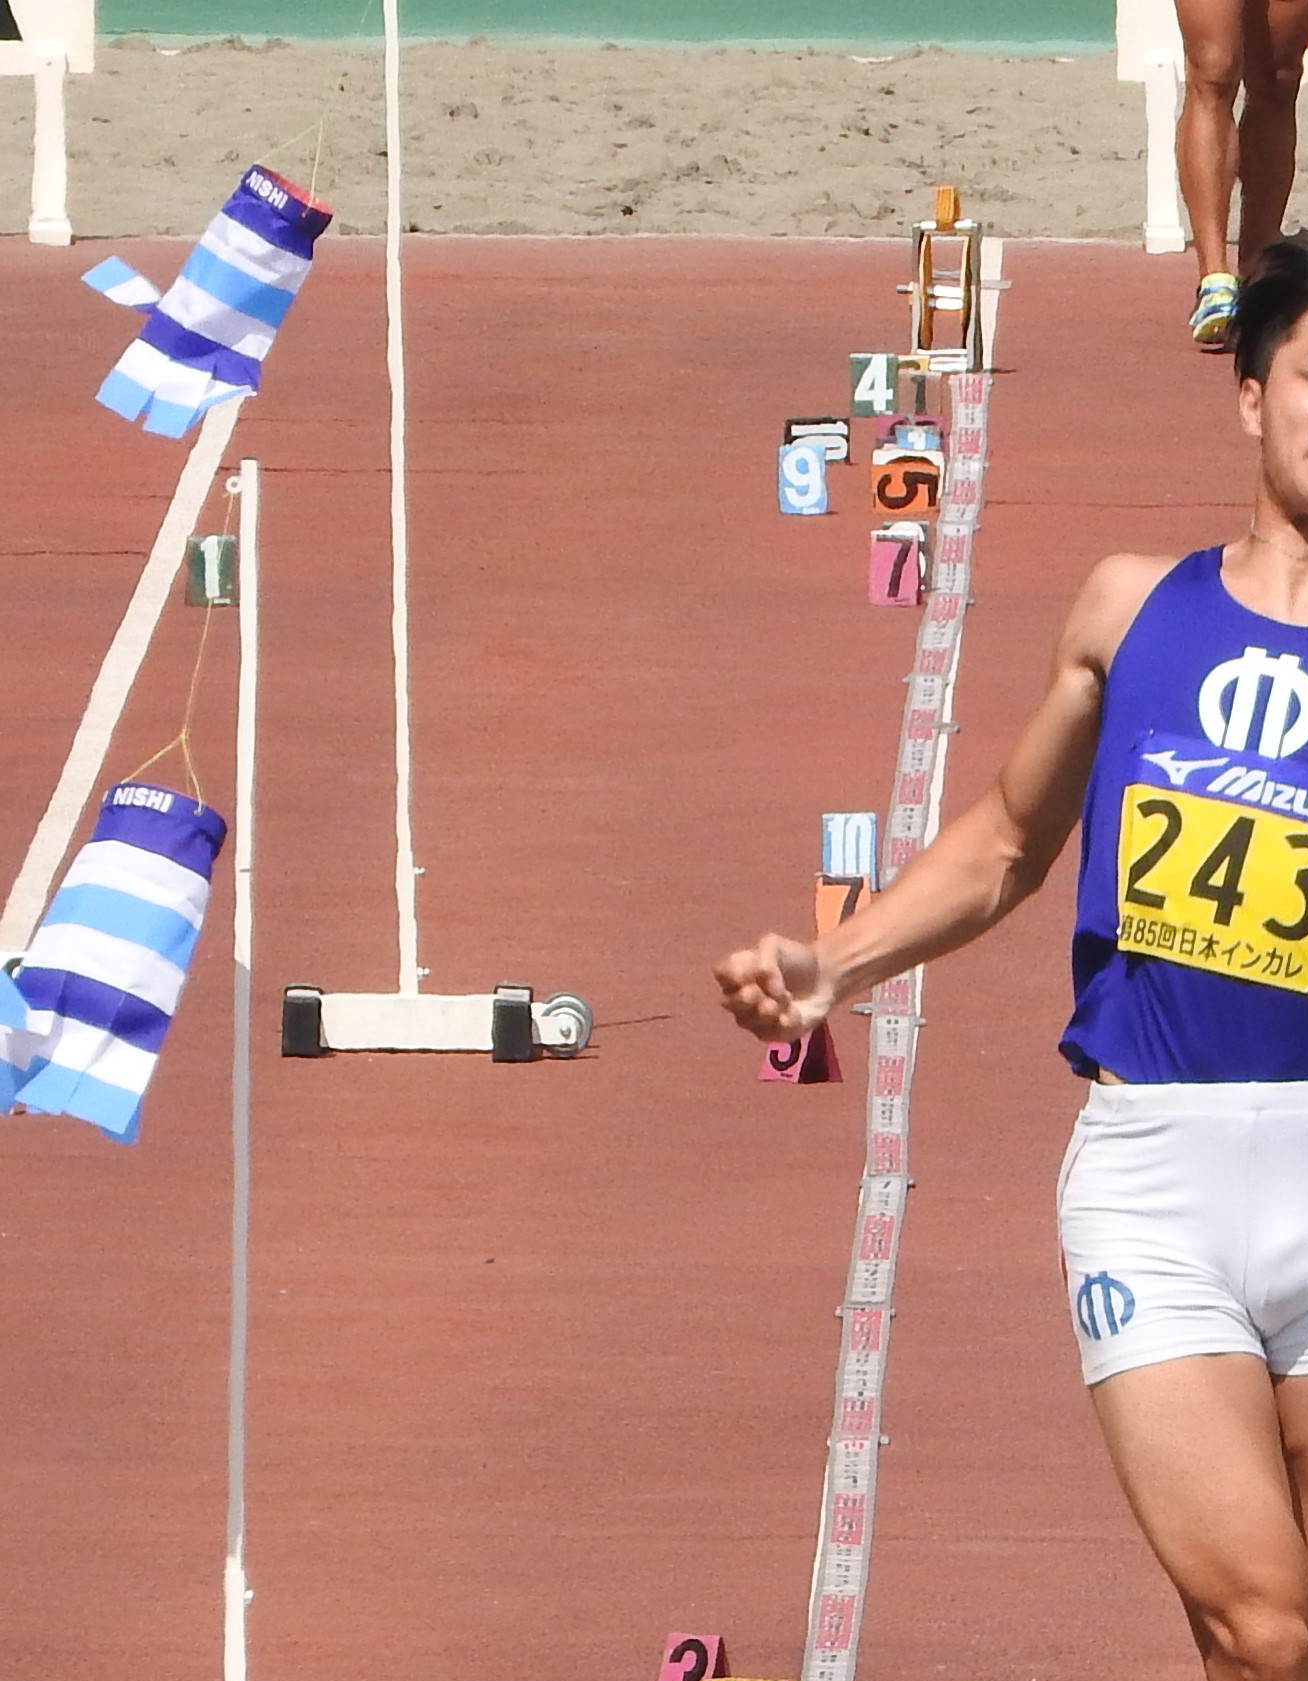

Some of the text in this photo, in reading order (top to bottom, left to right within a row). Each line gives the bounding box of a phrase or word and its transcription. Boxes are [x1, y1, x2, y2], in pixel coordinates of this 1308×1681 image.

[245, 170, 289, 210] NISHI
[854, 353, 894, 412] 4
[782, 447, 822, 508] 9
[877, 471, 938, 510] 5
[200, 534, 220, 599] 1
[876, 534, 914, 599] 7
[112, 786, 174, 814] NISHI
